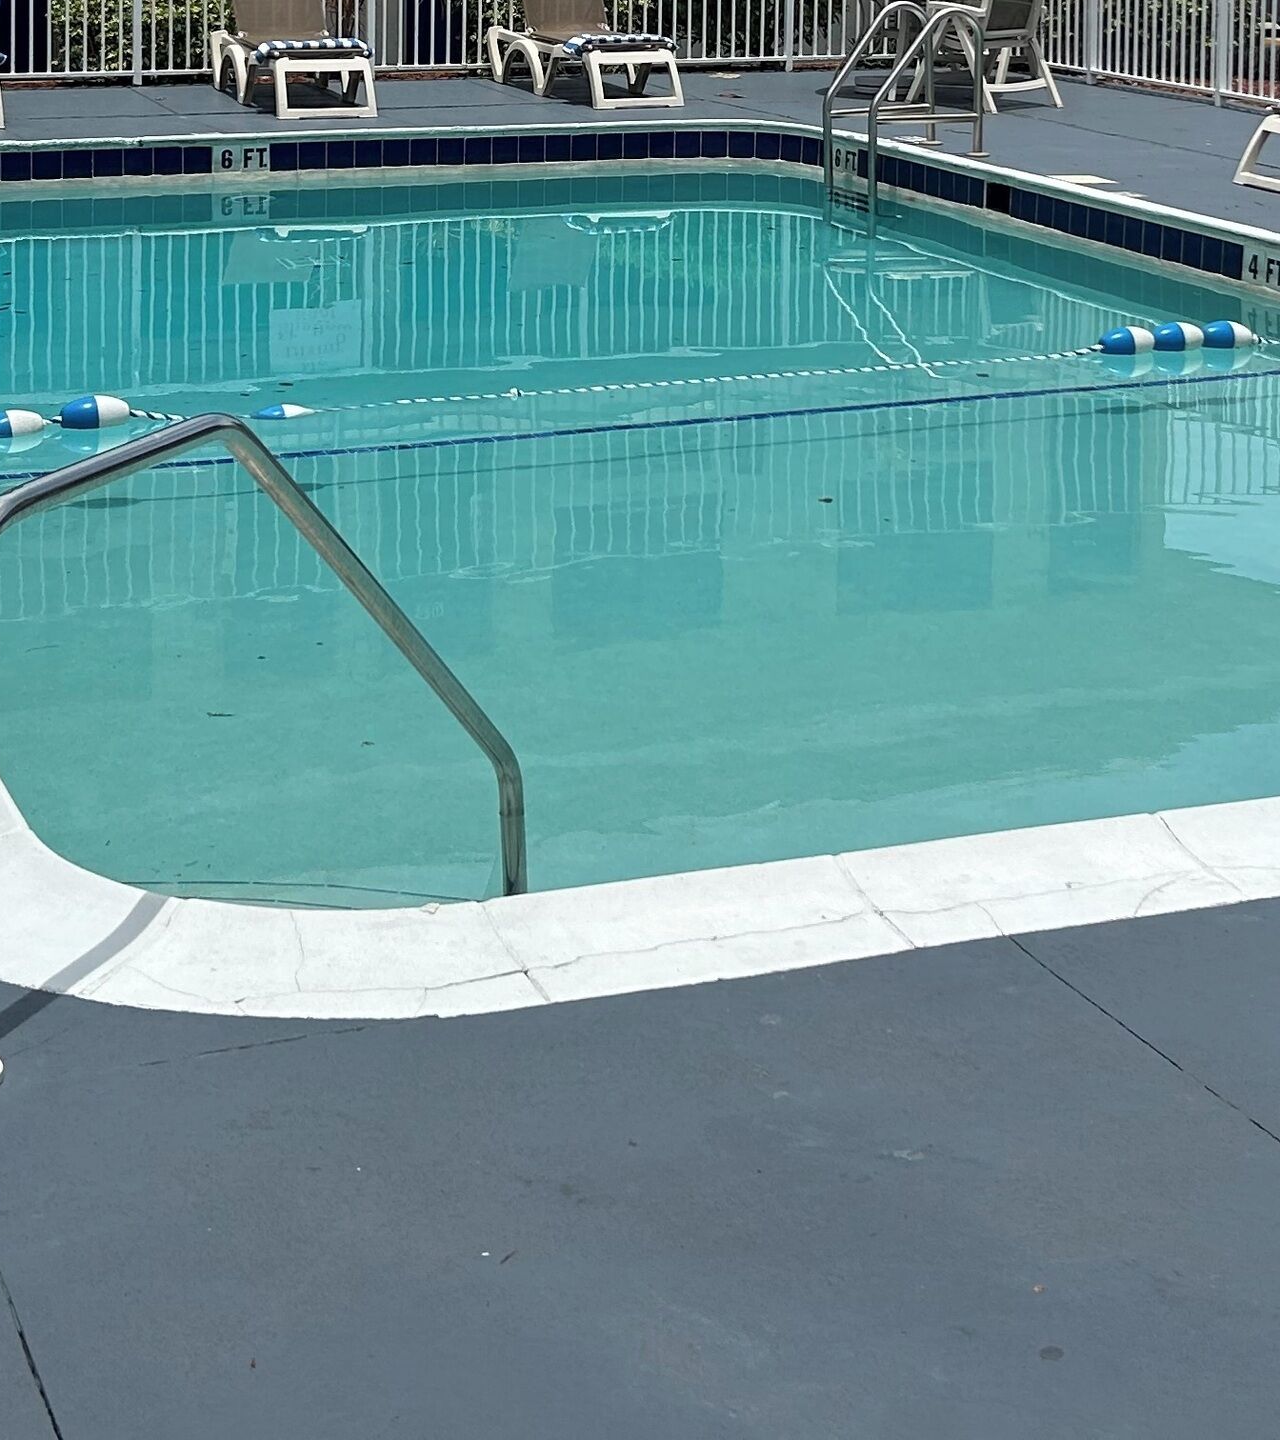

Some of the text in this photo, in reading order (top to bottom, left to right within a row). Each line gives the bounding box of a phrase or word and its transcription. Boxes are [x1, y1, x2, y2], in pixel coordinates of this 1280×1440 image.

[221, 149, 233, 169] 6
[834, 148, 841, 168] 6
[1248, 254, 1258, 280] 4
